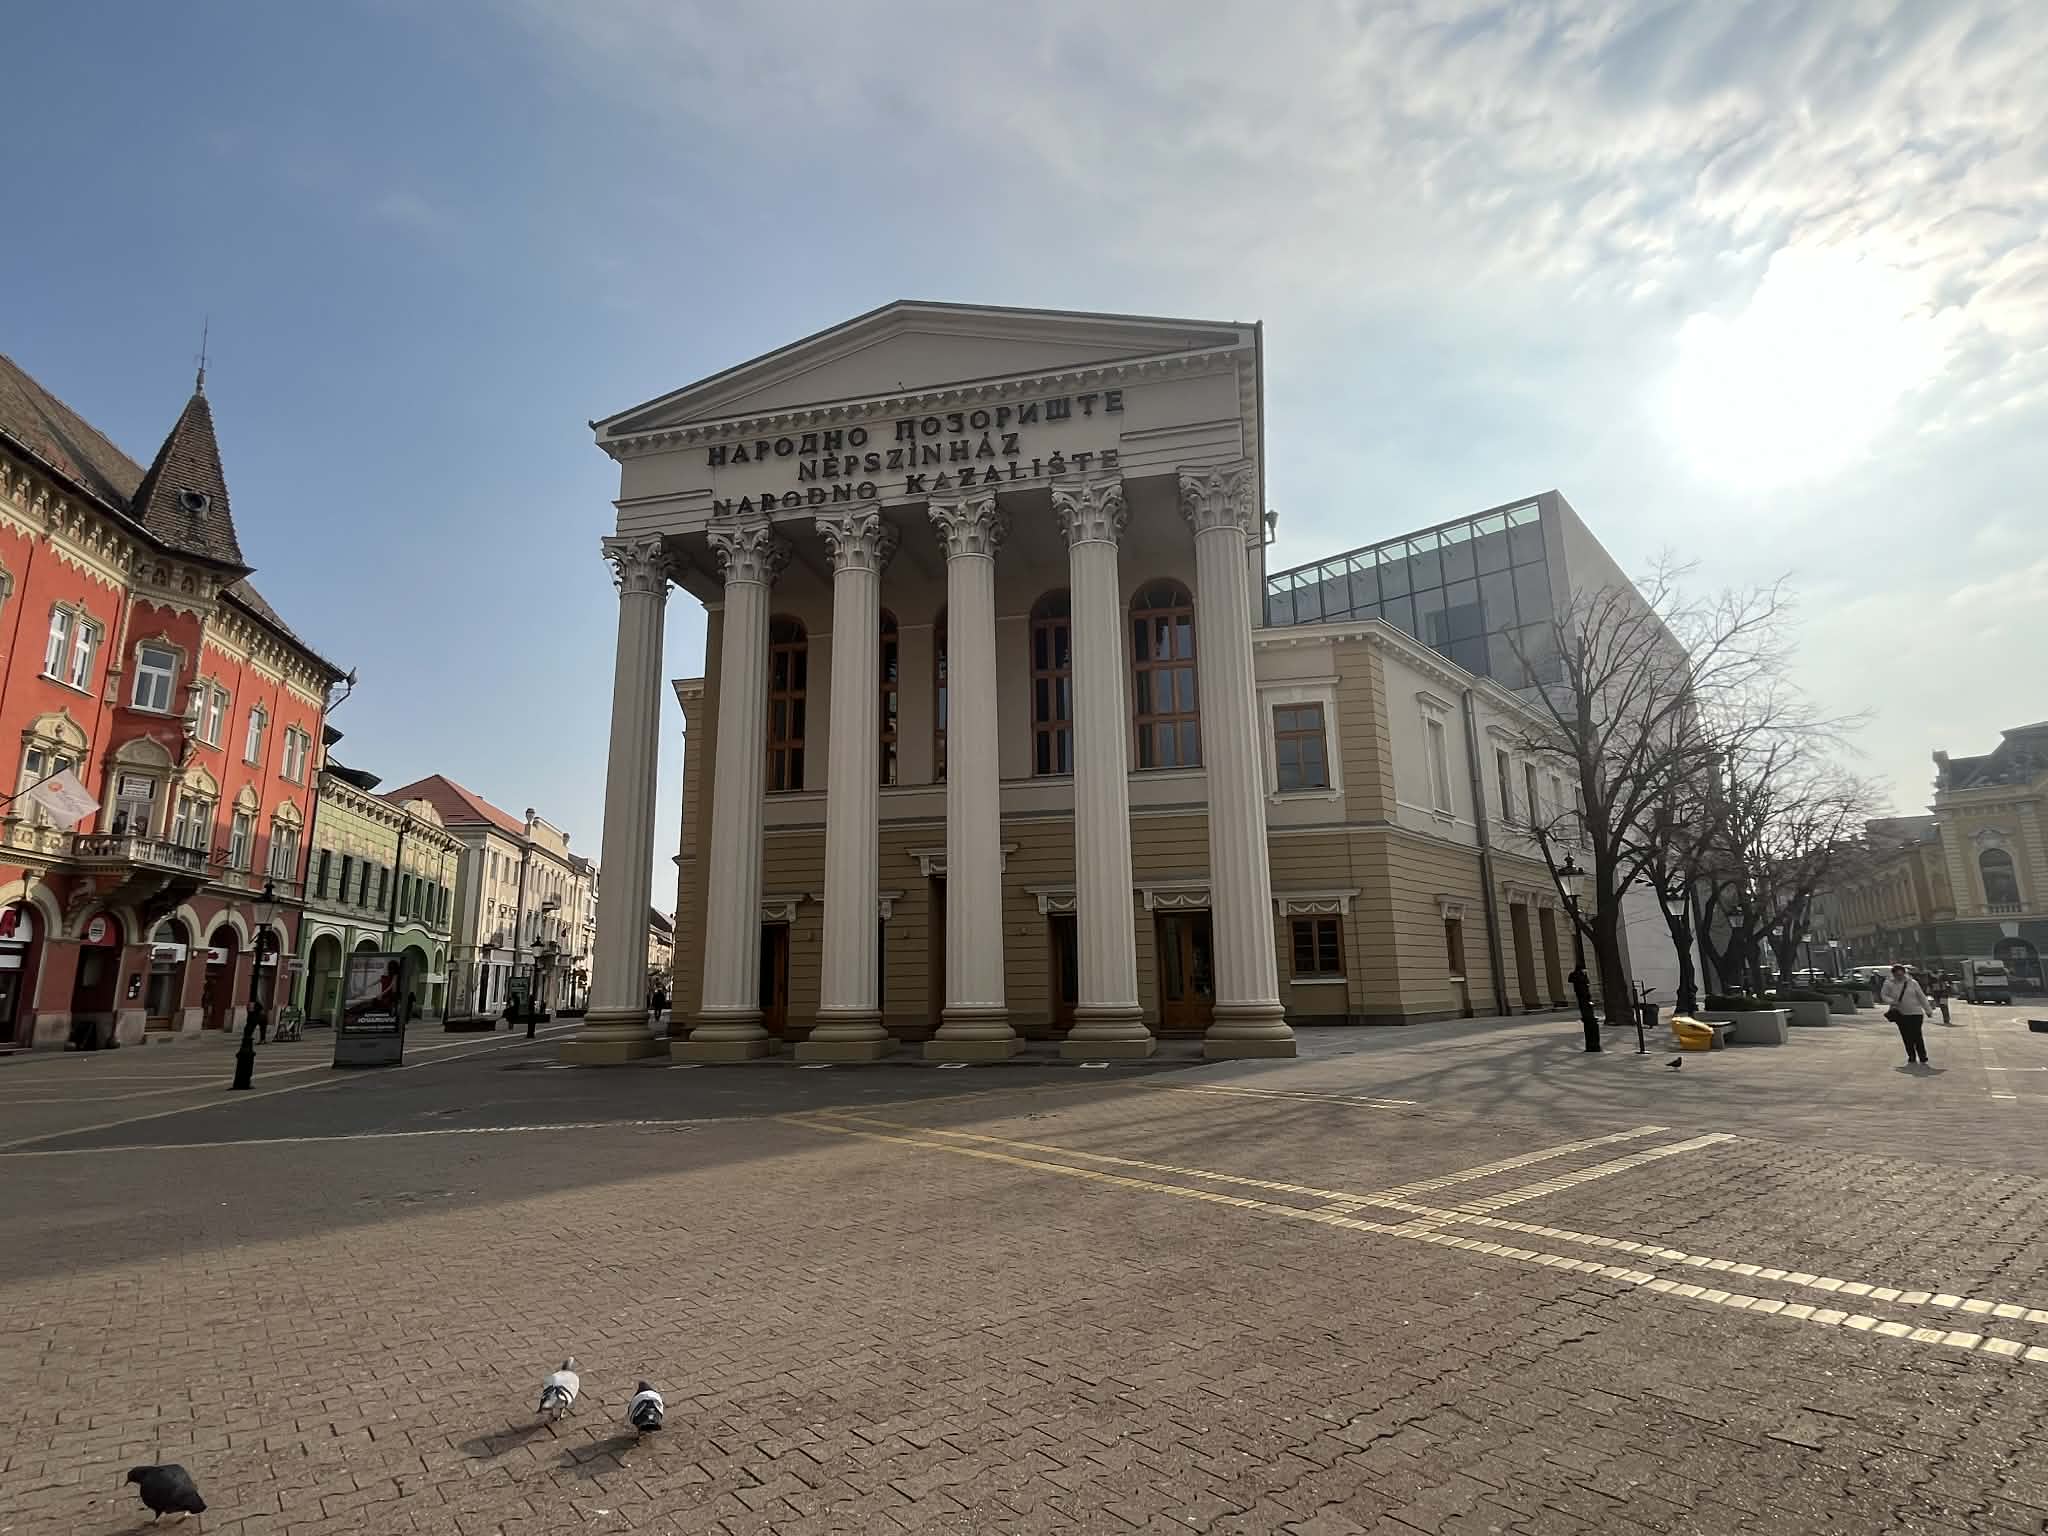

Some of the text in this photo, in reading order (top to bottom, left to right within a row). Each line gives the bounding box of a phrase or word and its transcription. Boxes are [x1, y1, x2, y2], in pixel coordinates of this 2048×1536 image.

[707, 390, 1124, 466] НАРОДНО ПОЗОРИШТЕ
[713, 449, 1120, 517] NARODNO KAZALIŠTE
